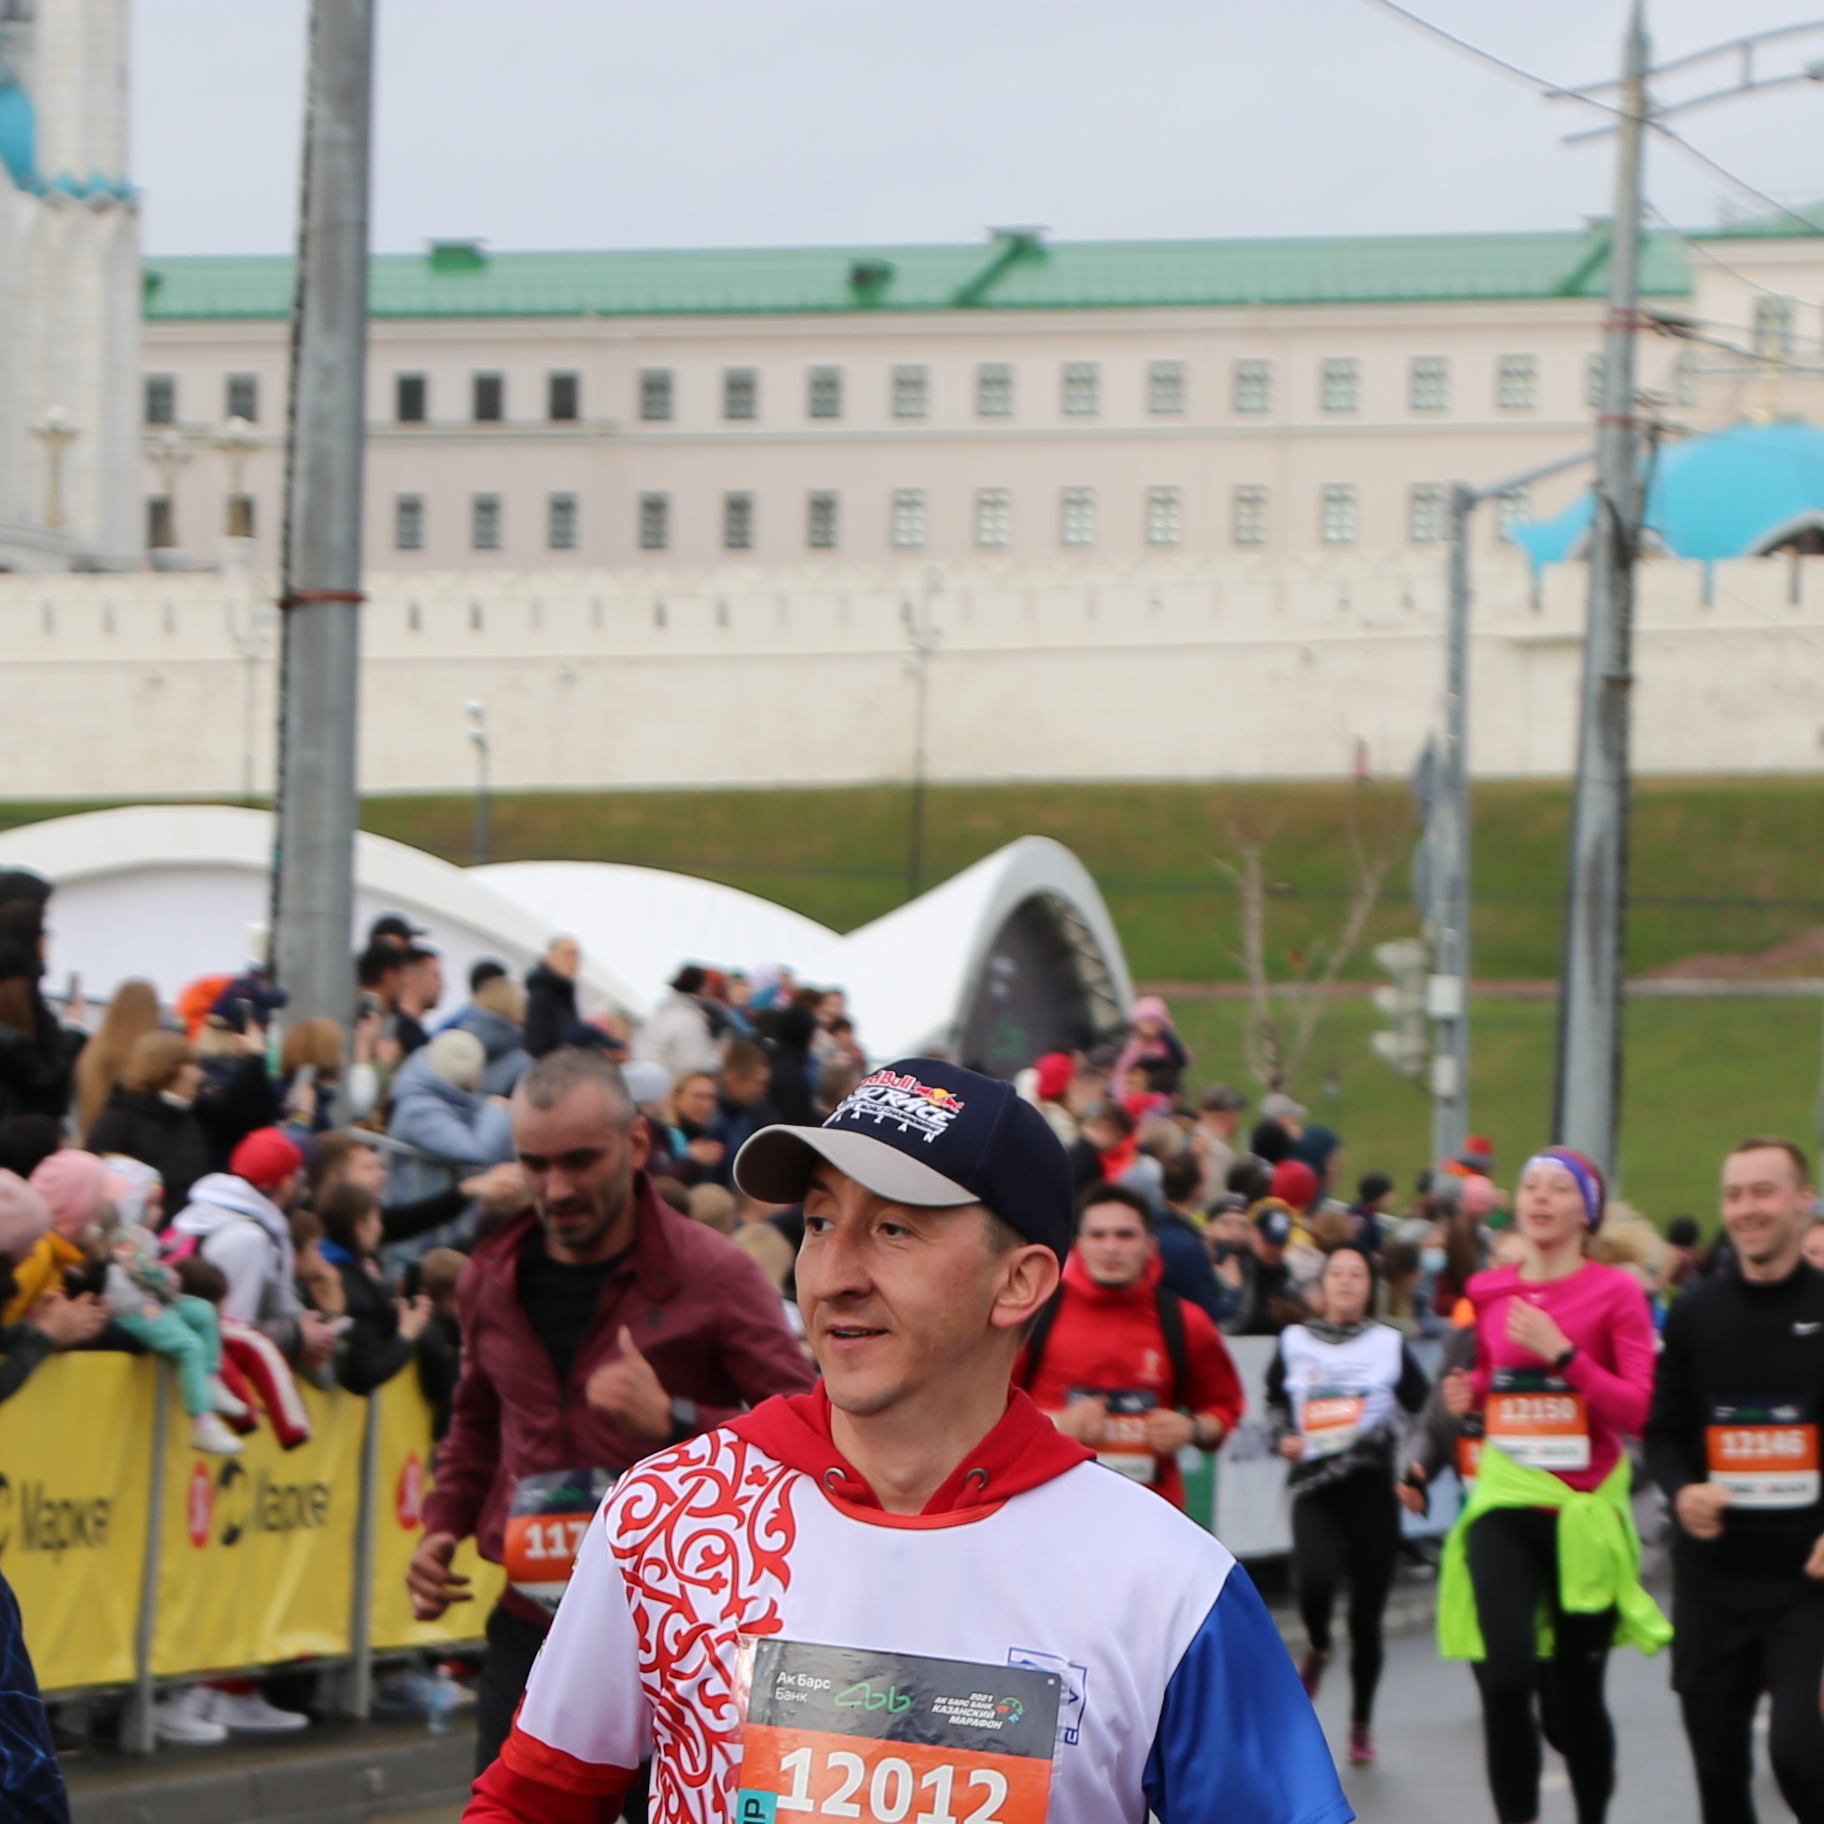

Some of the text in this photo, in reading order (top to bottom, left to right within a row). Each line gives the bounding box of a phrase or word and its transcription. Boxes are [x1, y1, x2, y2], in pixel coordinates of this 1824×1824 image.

[879, 1070, 917, 1091] Bull
[881, 1088, 957, 1127] RACE
[776, 1671, 831, 1690] Ак Барс
[775, 1686, 808, 1703] Банк
[932, 1704, 997, 1719] КАЗАНСКИЙ
[948, 1715, 1003, 1730] МАРАФОН
